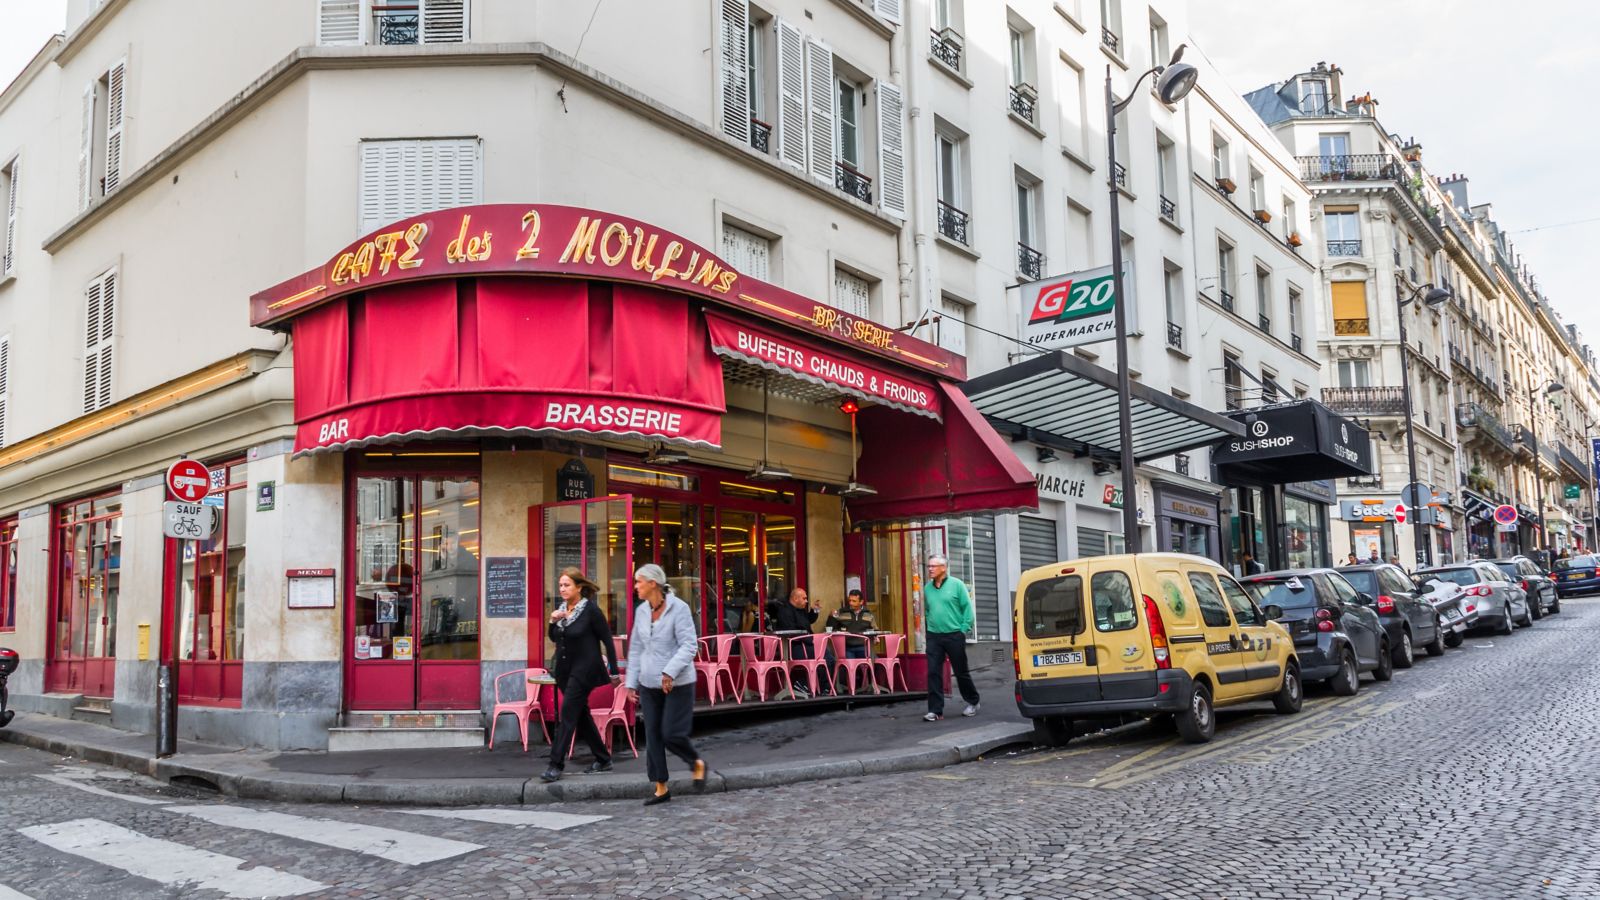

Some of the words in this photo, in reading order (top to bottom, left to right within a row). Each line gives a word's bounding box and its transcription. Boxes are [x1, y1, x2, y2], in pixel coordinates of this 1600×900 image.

[446, 214, 493, 263] des
[515, 209, 541, 262] 2
[558, 216, 737, 293] MOULINS
[1038, 279, 1115, 313] G20
[812, 305, 895, 351] BRASSERIE
[1028, 320, 1117, 344] SUPERMARCH
[738, 331, 804, 367] BUFFETS
[810, 356, 864, 387] CHAUDS
[869, 376, 878, 392] &
[883, 379, 927, 406] FROIDS
[545, 402, 682, 433] BRASSERIE
[319, 418, 348, 442] BAR
[1231, 436, 1294, 453] SUSHISHOP
[565, 488, 588, 499] LEPIC
[568, 479, 585, 489] RUE
[1104, 487, 1123, 504] G20
[177, 504, 202, 516] SAUF
[1208, 645, 1215, 653] LA
[1216, 642, 1231, 652] POSTE
[1040, 655, 1054, 665] 782
[1071, 652, 1081, 662] 75
